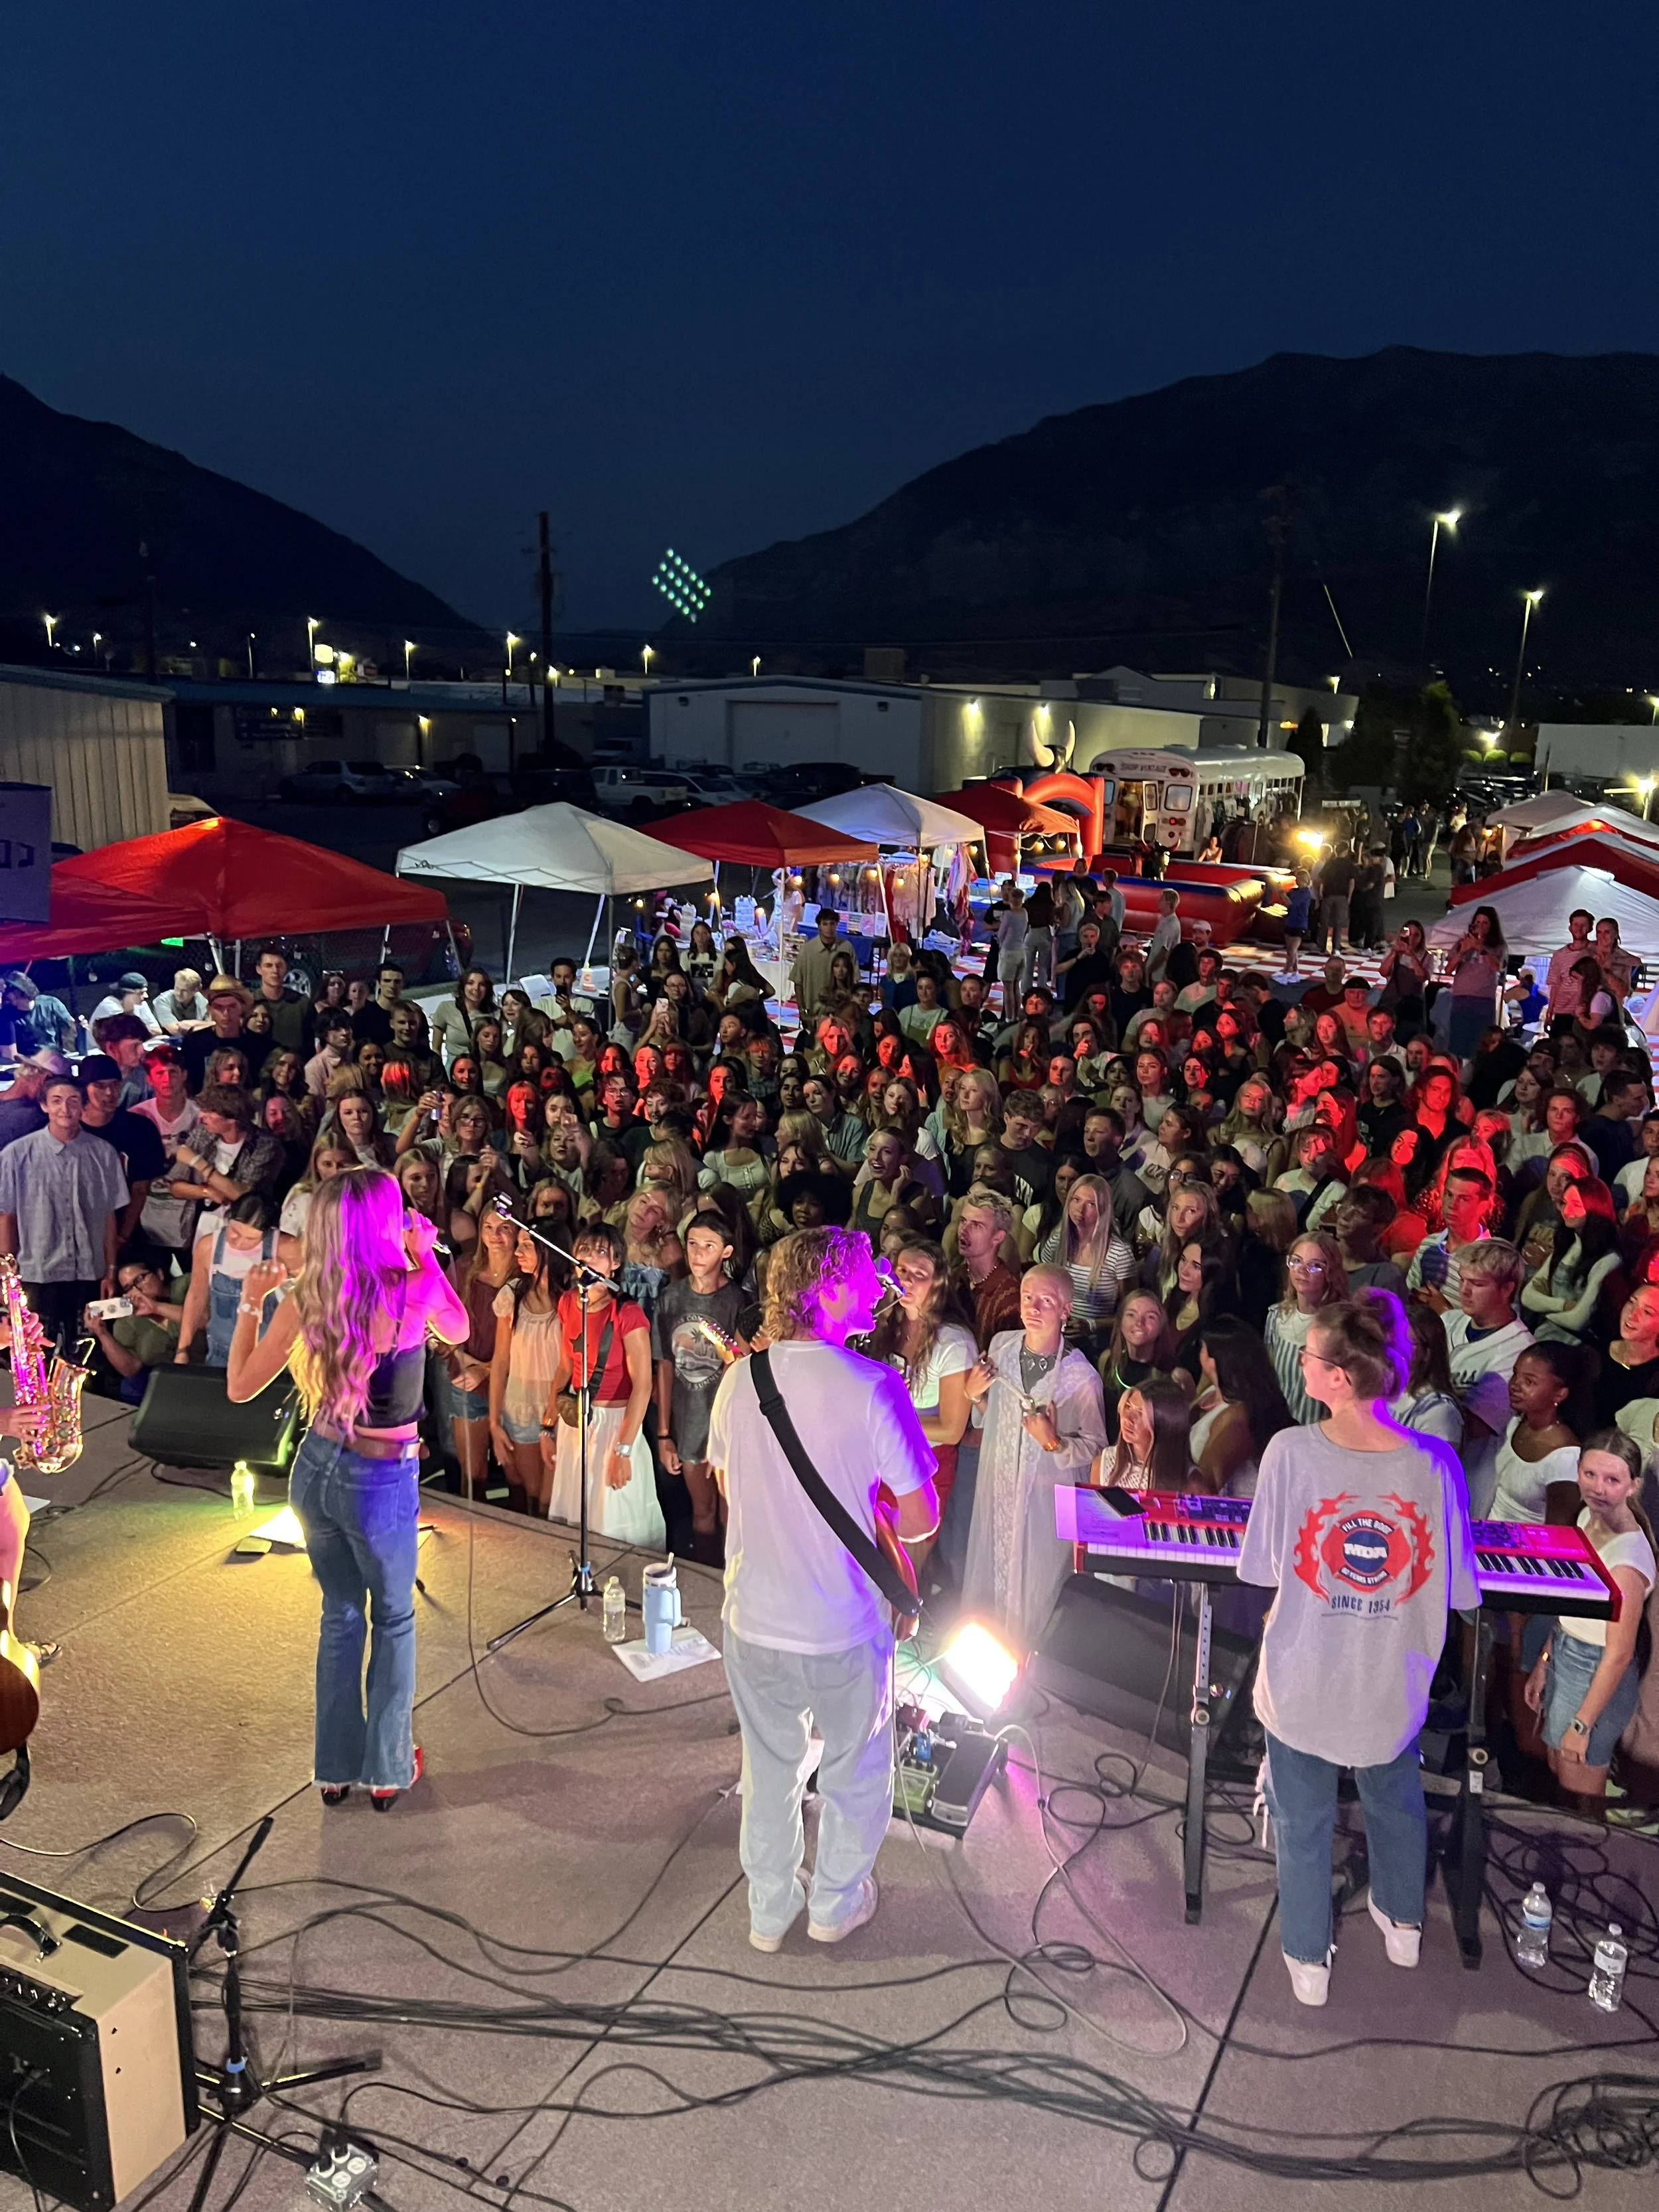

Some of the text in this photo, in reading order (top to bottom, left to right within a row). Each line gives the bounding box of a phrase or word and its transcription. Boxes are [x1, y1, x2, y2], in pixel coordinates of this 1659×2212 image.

[1342, 1520, 1358, 1532] FILL
[1358, 1518, 1372, 1528] THE
[1343, 1543, 1388, 1559] MDA
[1331, 1595, 1390, 1614] SINCE 1954
